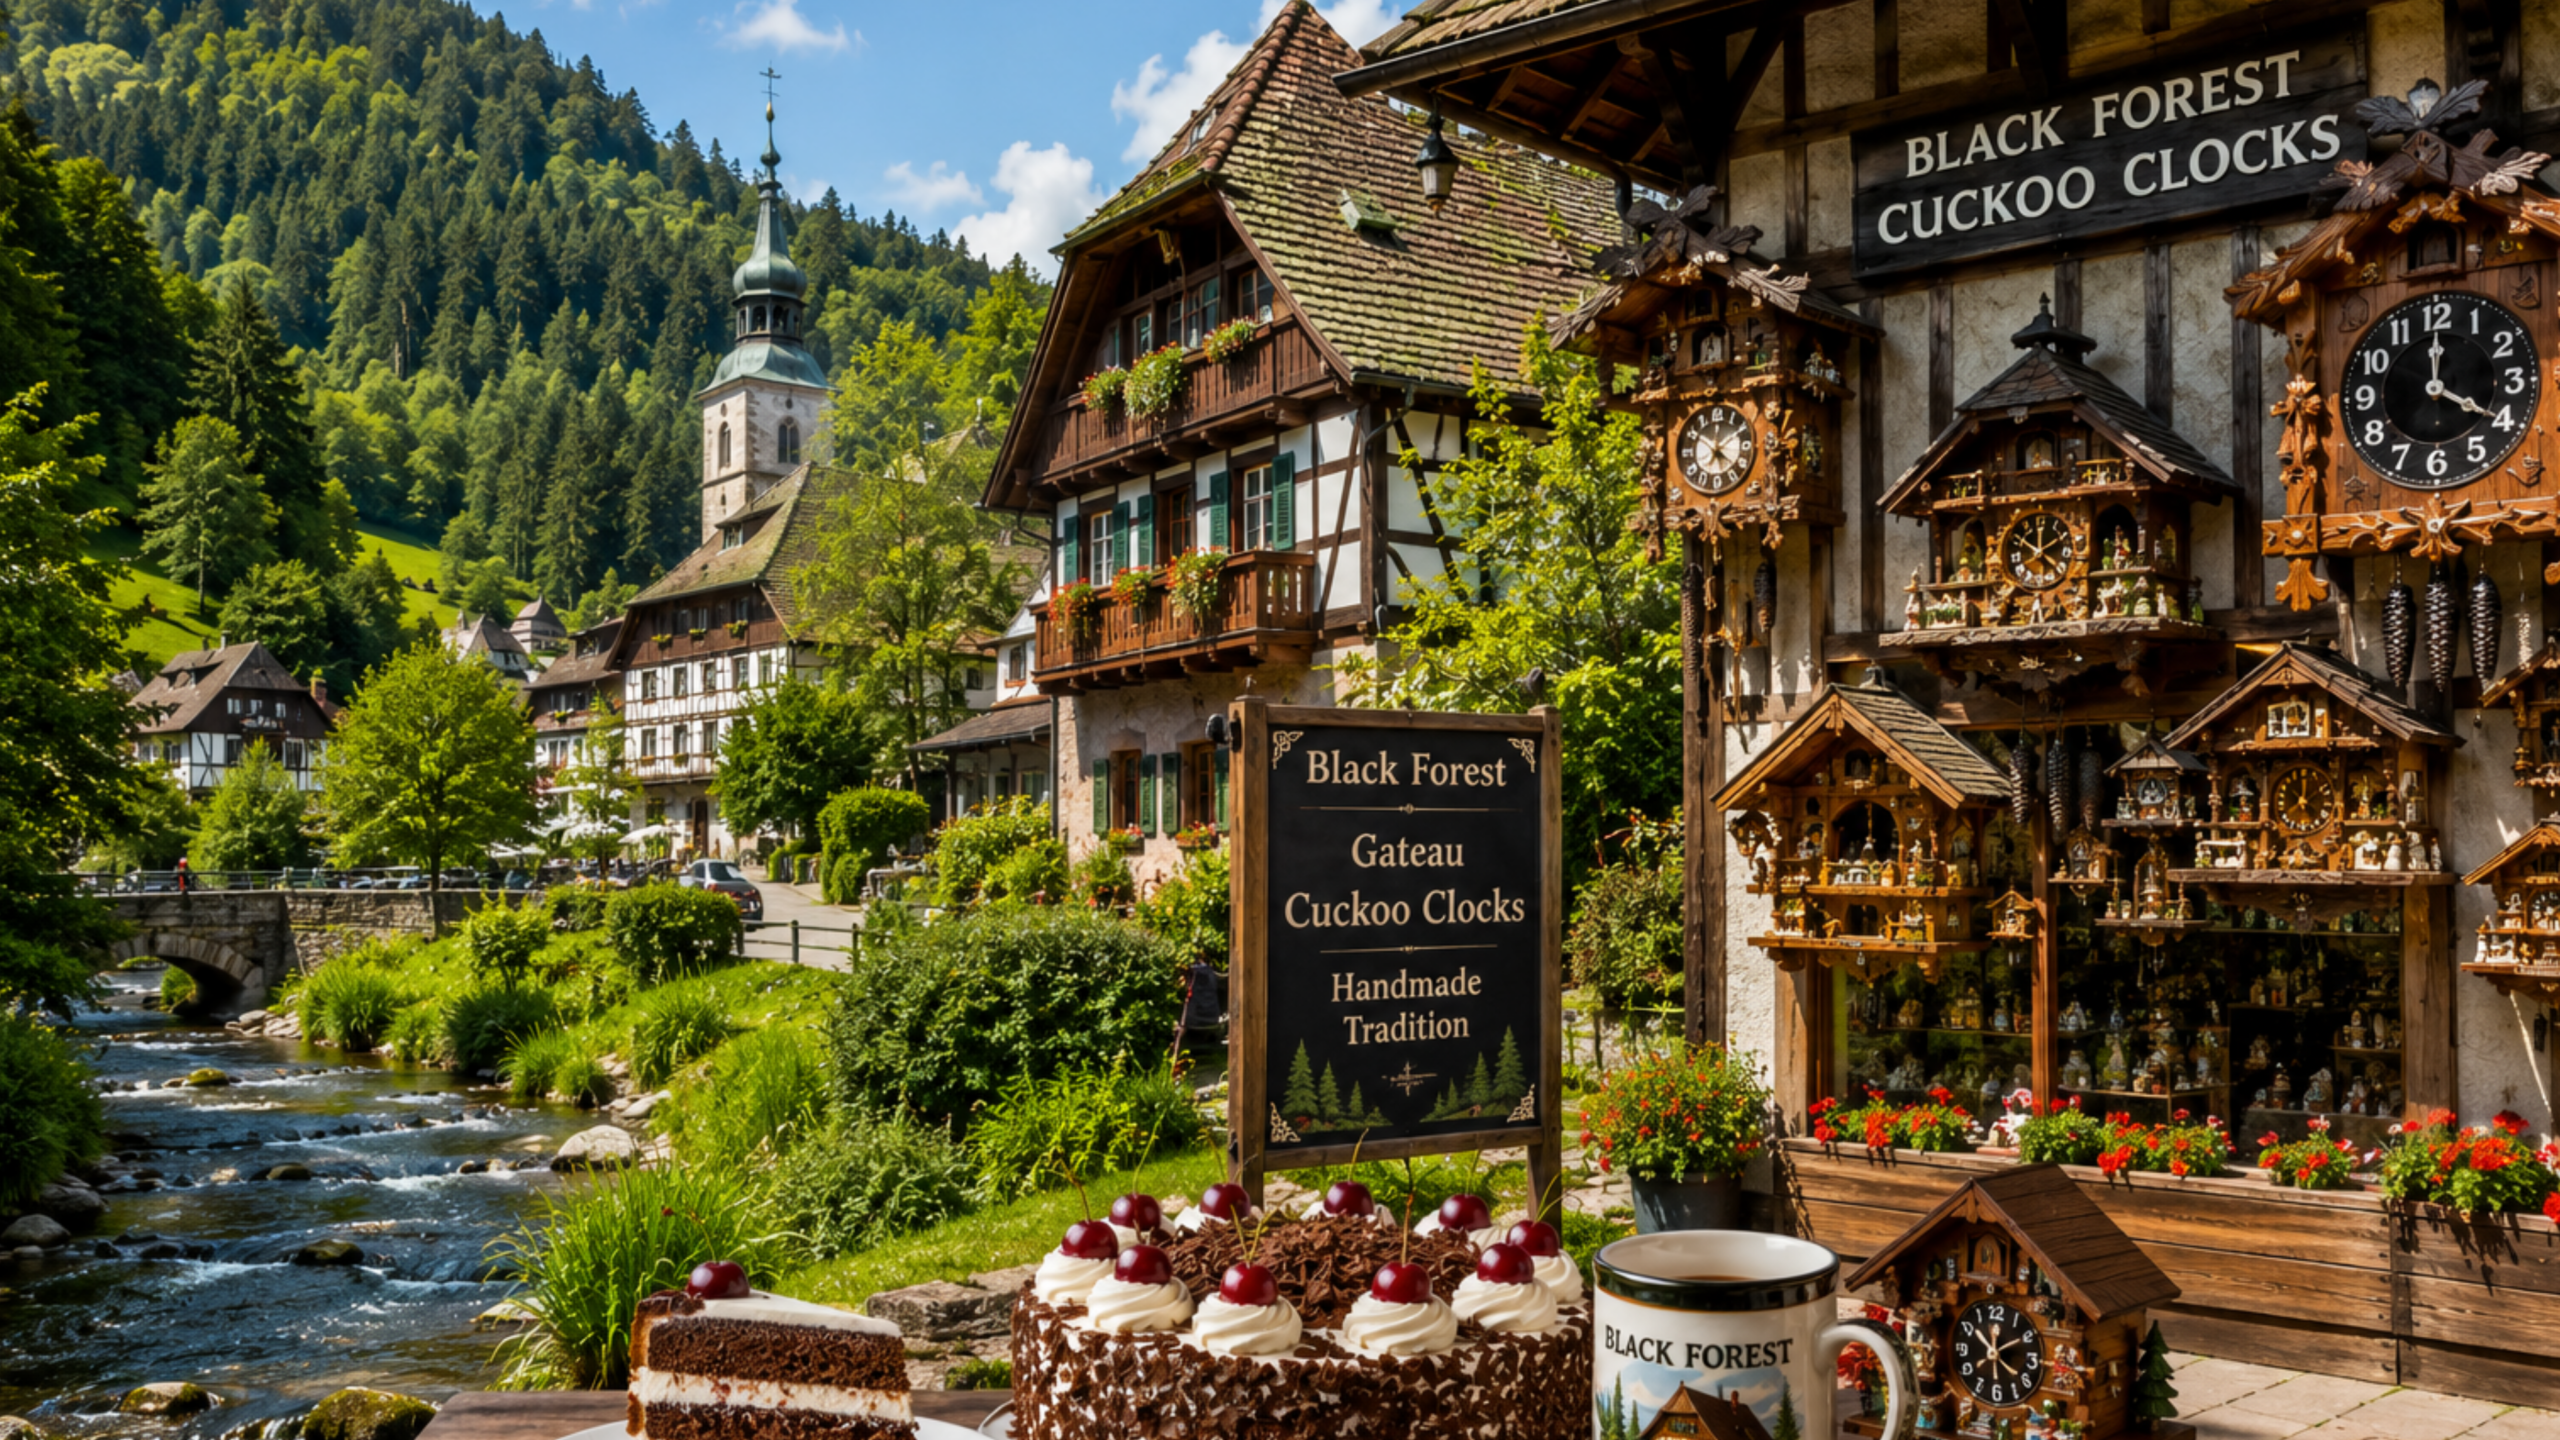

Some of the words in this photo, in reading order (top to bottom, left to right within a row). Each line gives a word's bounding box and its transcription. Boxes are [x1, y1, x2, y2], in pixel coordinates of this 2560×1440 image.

[1905, 106, 2064, 178] BLACK
[2092, 50, 2299, 138] FOREST
[1877, 166, 2095, 244] CUCKOO
[2123, 114, 2340, 196] CLOCKS
[2422, 302, 2452, 332] 12
[2469, 307, 2479, 335] 1
[2390, 318, 2410, 346] 11
[2492, 330, 2514, 359] 2
[2363, 348, 2390, 375] 10
[2504, 366, 2525, 395] 3
[2355, 384, 2376, 411] 9
[2363, 419, 2385, 446] 8
[2491, 404, 2515, 432] 4
[2391, 443, 2411, 470] 7
[2426, 448, 2448, 477] 6
[2466, 434, 2487, 463] 5
[1306, 749, 1400, 785] Black
[1411, 752, 1507, 787] Forest
[1351, 832, 1464, 868] Gateau
[1284, 889, 1411, 928] Cuckoo
[1422, 887, 1525, 925] Clocks
[1331, 966, 1482, 1002] Handmade
[1343, 1010, 1469, 1045] Tradition
[1988, 1304, 2005, 1322] 12
[1605, 1324, 1674, 1367] BLACK
[1685, 1337, 1794, 1370] FOREST
[2025, 1352, 2038, 1370] 3
